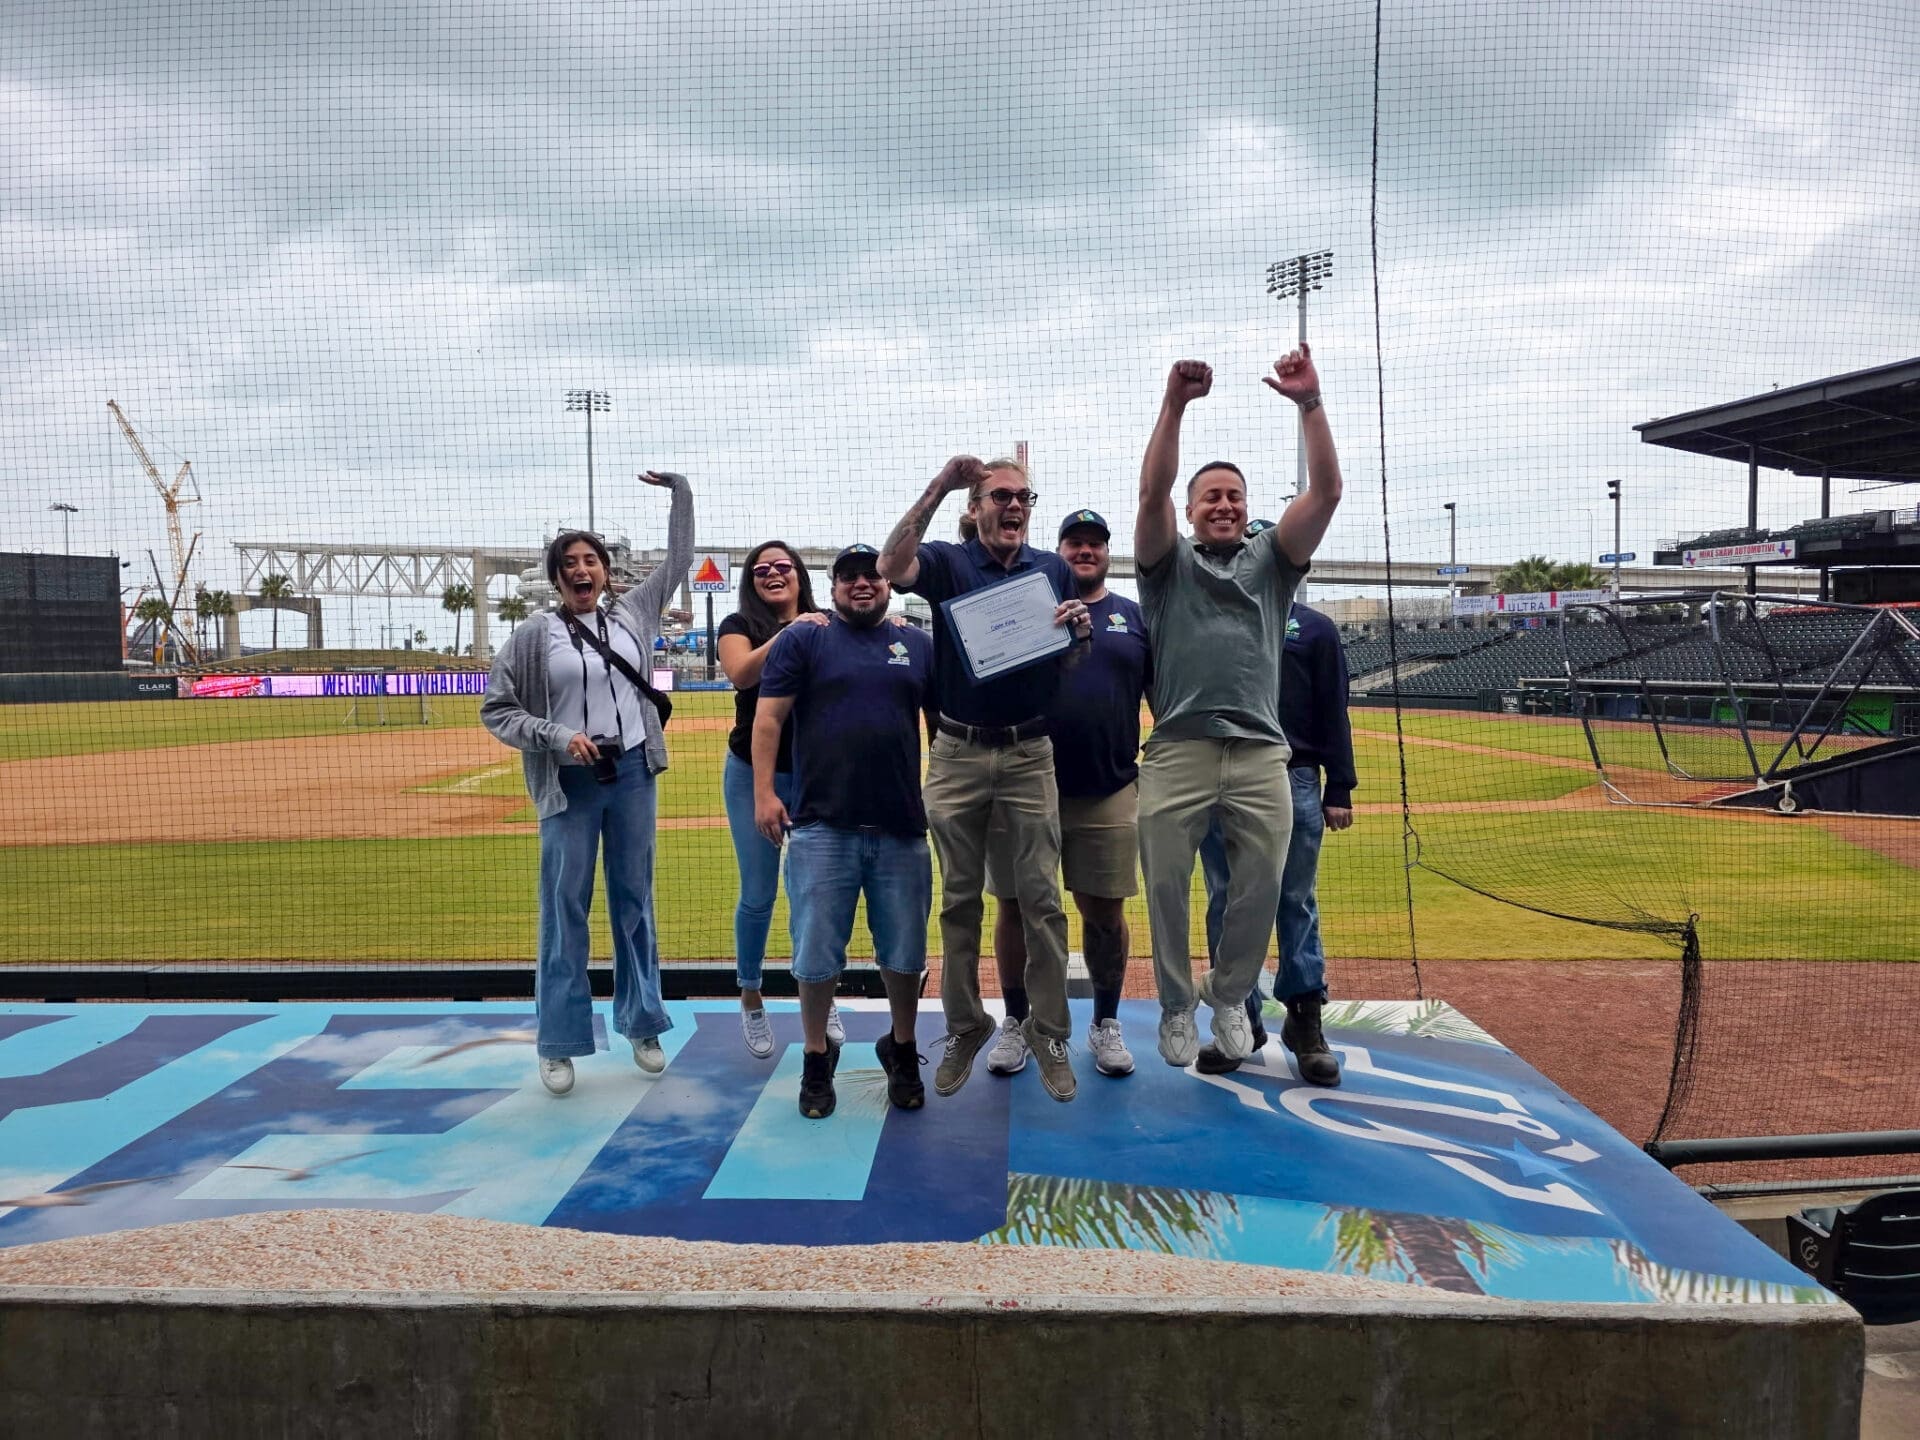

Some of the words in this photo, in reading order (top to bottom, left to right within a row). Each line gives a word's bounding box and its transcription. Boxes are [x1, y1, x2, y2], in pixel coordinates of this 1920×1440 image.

[1699, 549, 1714, 559] MIKE
[1715, 547, 1733, 557] SHAW
[1734, 544, 1775, 555] AUTOMOTIVE
[693, 582, 725, 591] CITGO
[1508, 602, 1545, 612] ULTRA
[322, 674, 389, 695] WELCOME
[396, 674, 412, 695] TO
